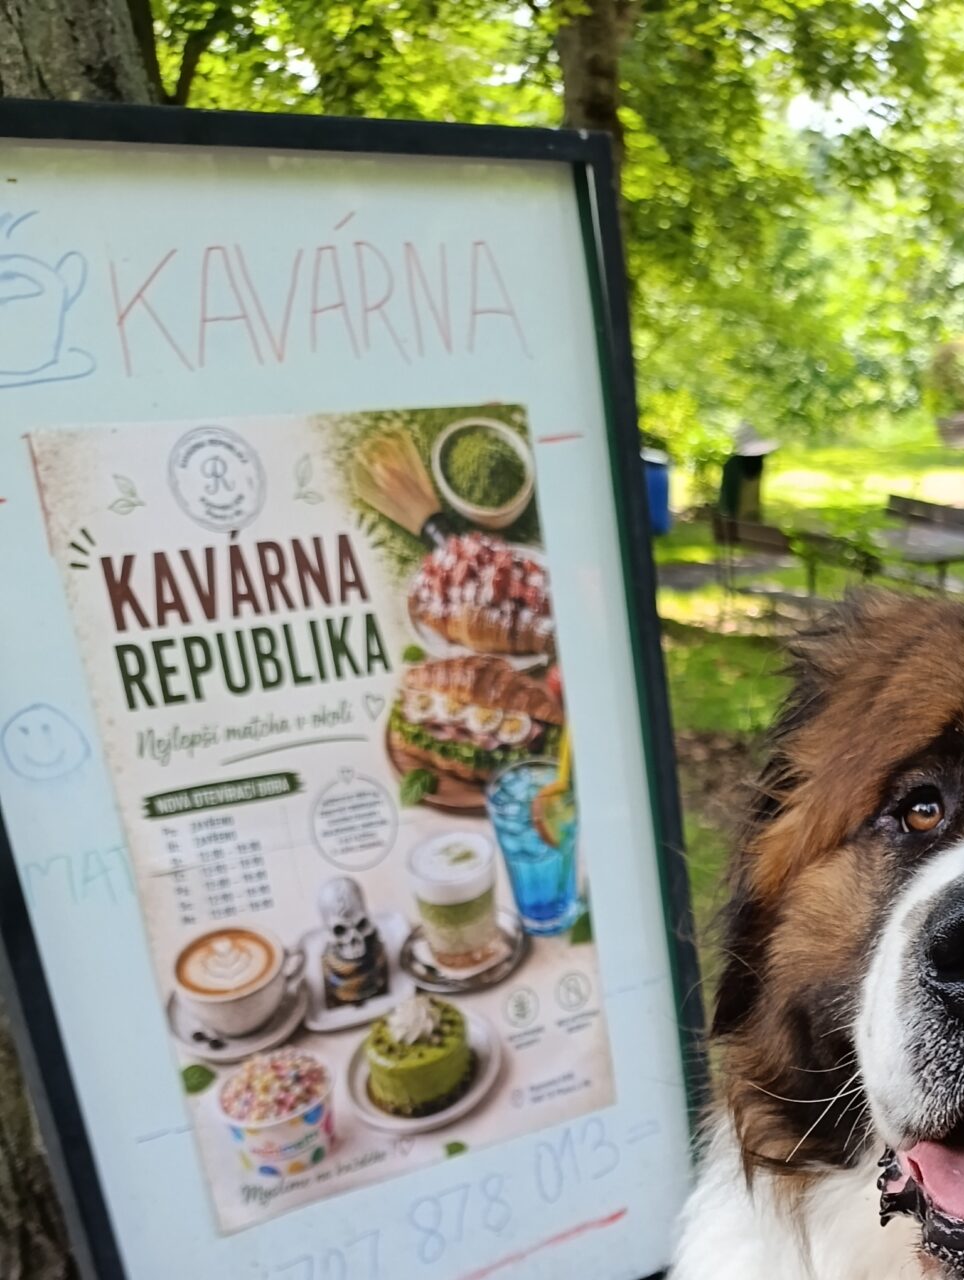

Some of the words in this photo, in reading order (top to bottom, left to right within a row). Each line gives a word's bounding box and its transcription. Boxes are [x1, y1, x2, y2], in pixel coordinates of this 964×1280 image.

[109, 211, 534, 377] KAVÁRNA
[101, 530, 369, 632] KAVÁRNA
[115, 613, 391, 711] REPUBLIKA
[226, 714, 291, 743] matcha
[408, 1174, 512, 1265] 878
